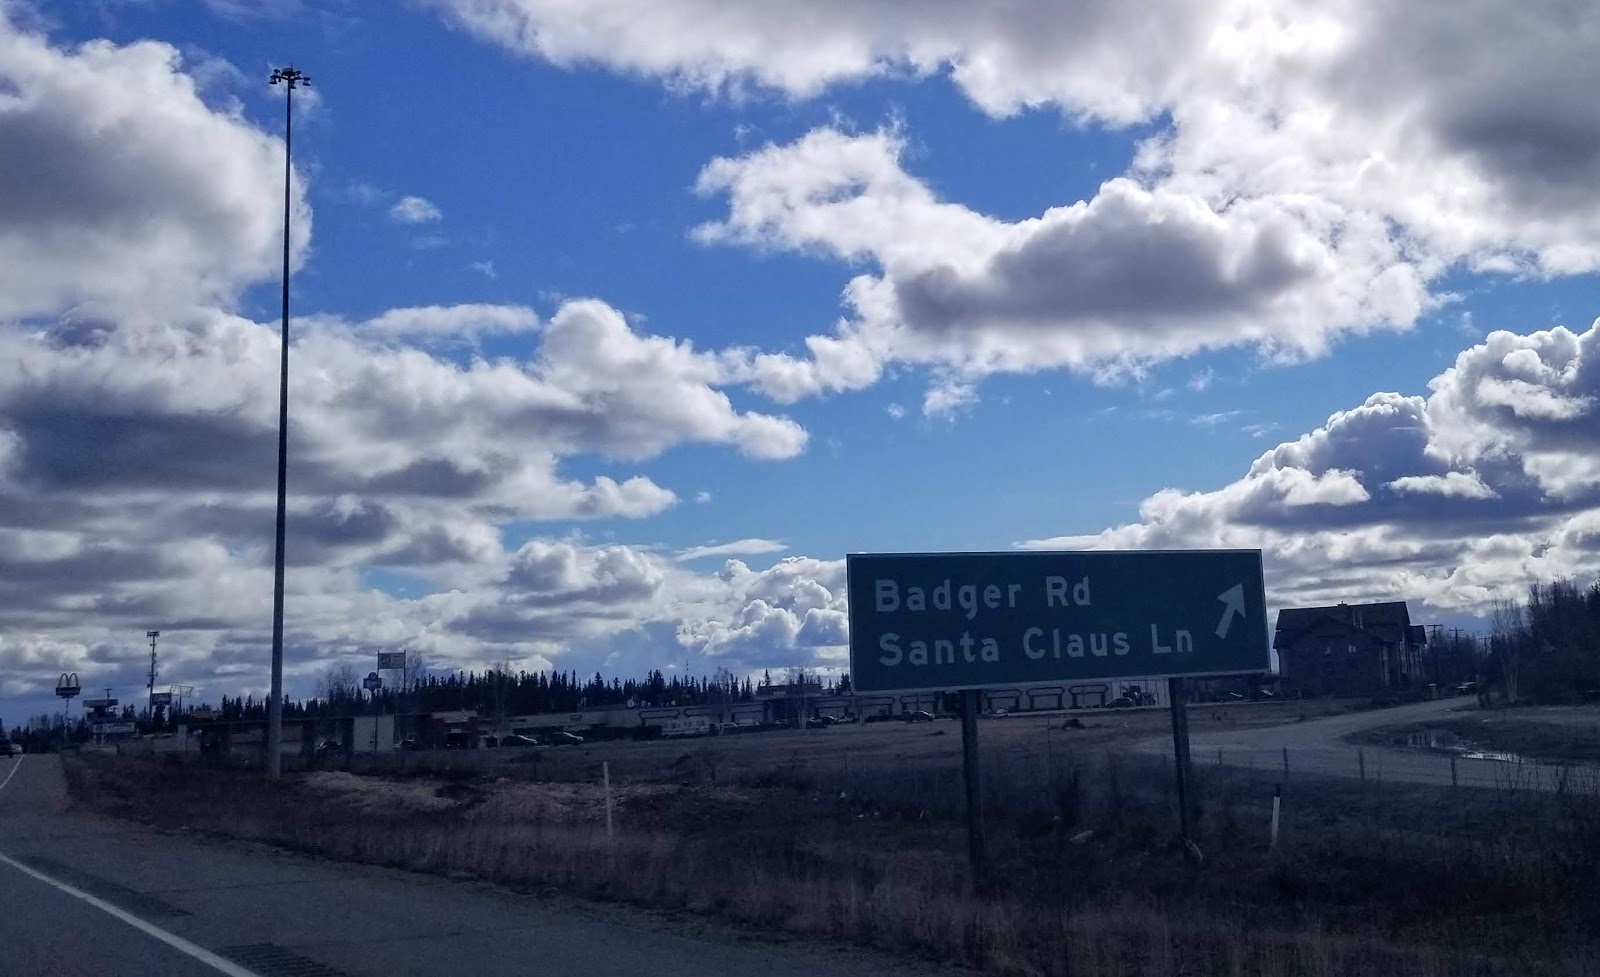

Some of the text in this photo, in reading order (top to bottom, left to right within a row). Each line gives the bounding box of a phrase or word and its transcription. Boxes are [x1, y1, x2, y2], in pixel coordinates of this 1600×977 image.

[875, 576, 1090, 619] Badger Rd
[879, 623, 1193, 666] Santa Claus Ln
